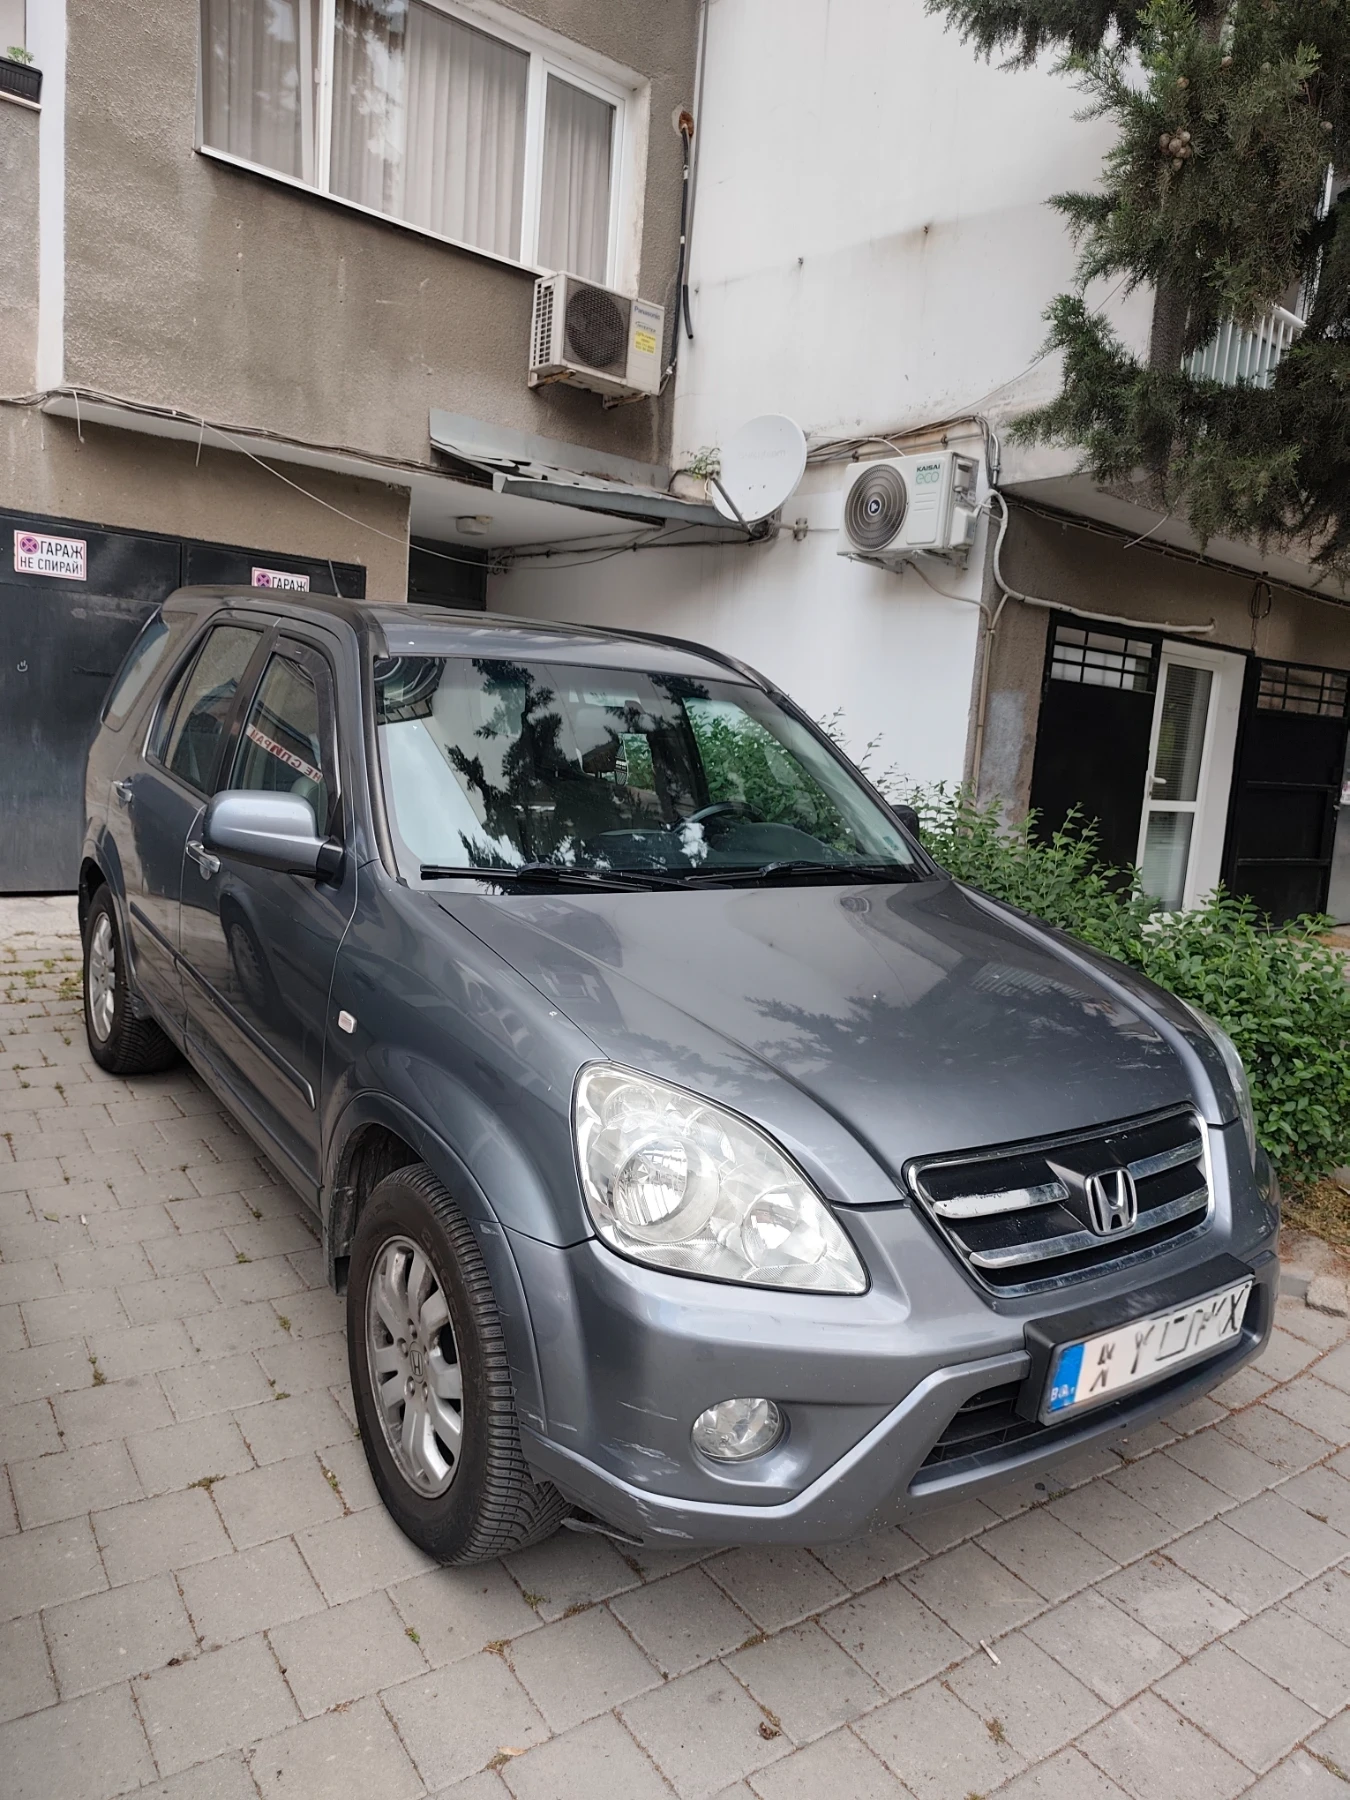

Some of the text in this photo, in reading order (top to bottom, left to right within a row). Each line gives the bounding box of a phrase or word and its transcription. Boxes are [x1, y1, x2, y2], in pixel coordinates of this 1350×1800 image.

[633, 305, 661, 321] Panasonic
[916, 463, 941, 473] KAISAI
[915, 471, 940, 485] eco
[40, 540, 83, 560] ГАРАЖ
[20, 556, 83, 576] НЕ СПИРАЙ!
[272, 576, 307, 592] ГАРАЖ
